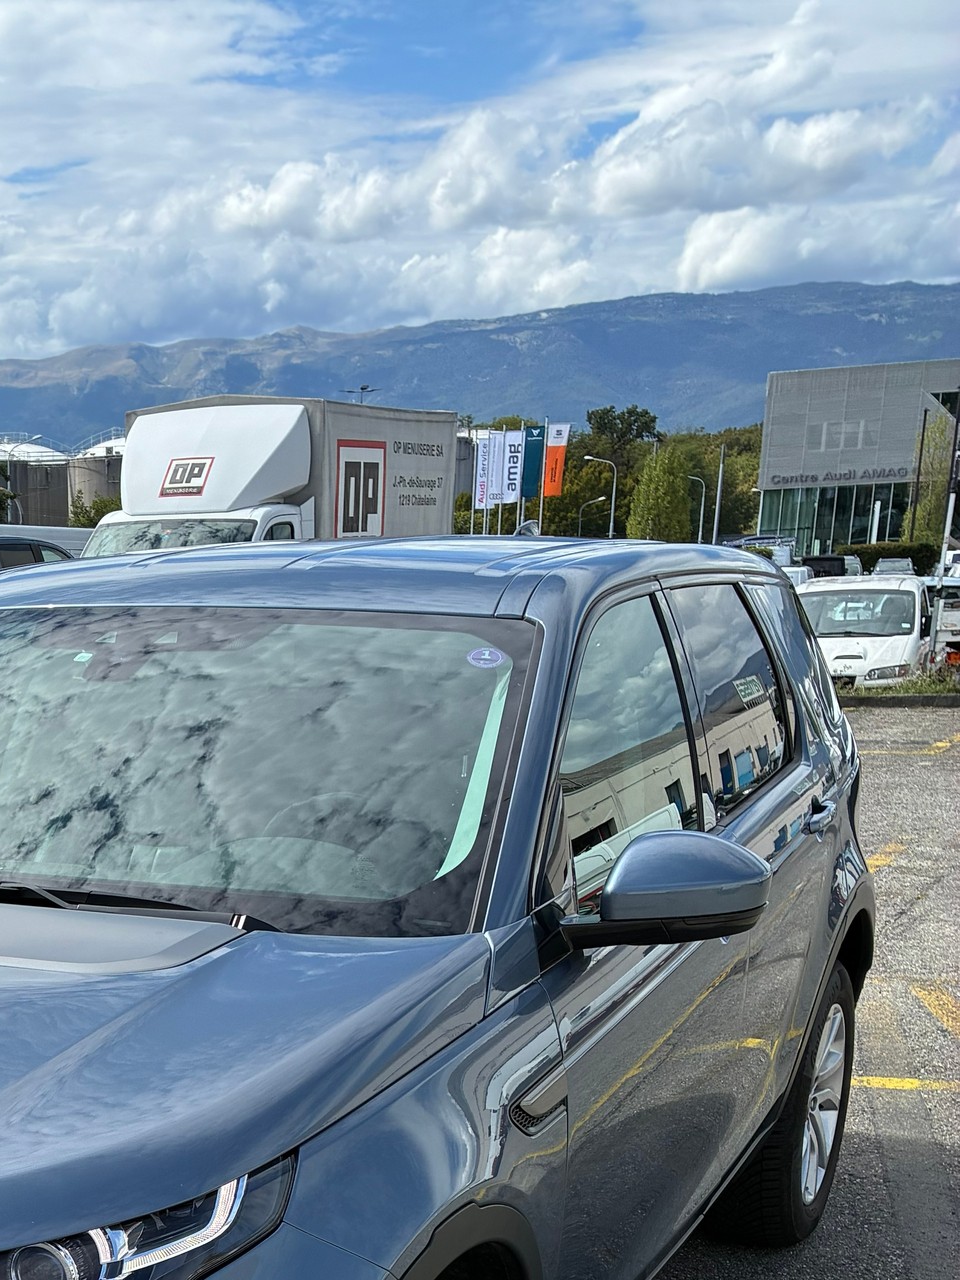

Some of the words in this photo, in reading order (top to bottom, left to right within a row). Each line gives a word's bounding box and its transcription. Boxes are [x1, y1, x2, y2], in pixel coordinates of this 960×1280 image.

[393, 441, 402, 453] OP
[403, 442, 435, 456] MENUISERIE
[436, 445, 444, 457] SA
[480, 443, 488, 478] Service
[507, 444, 522, 491] amag
[169, 463, 206, 484] OP
[771, 474, 819, 485] Centre
[823, 469, 856, 482] Audi
[861, 467, 908, 479] AMAG
[343, 461, 379, 533] OP
[478, 481, 486, 503] Audi
